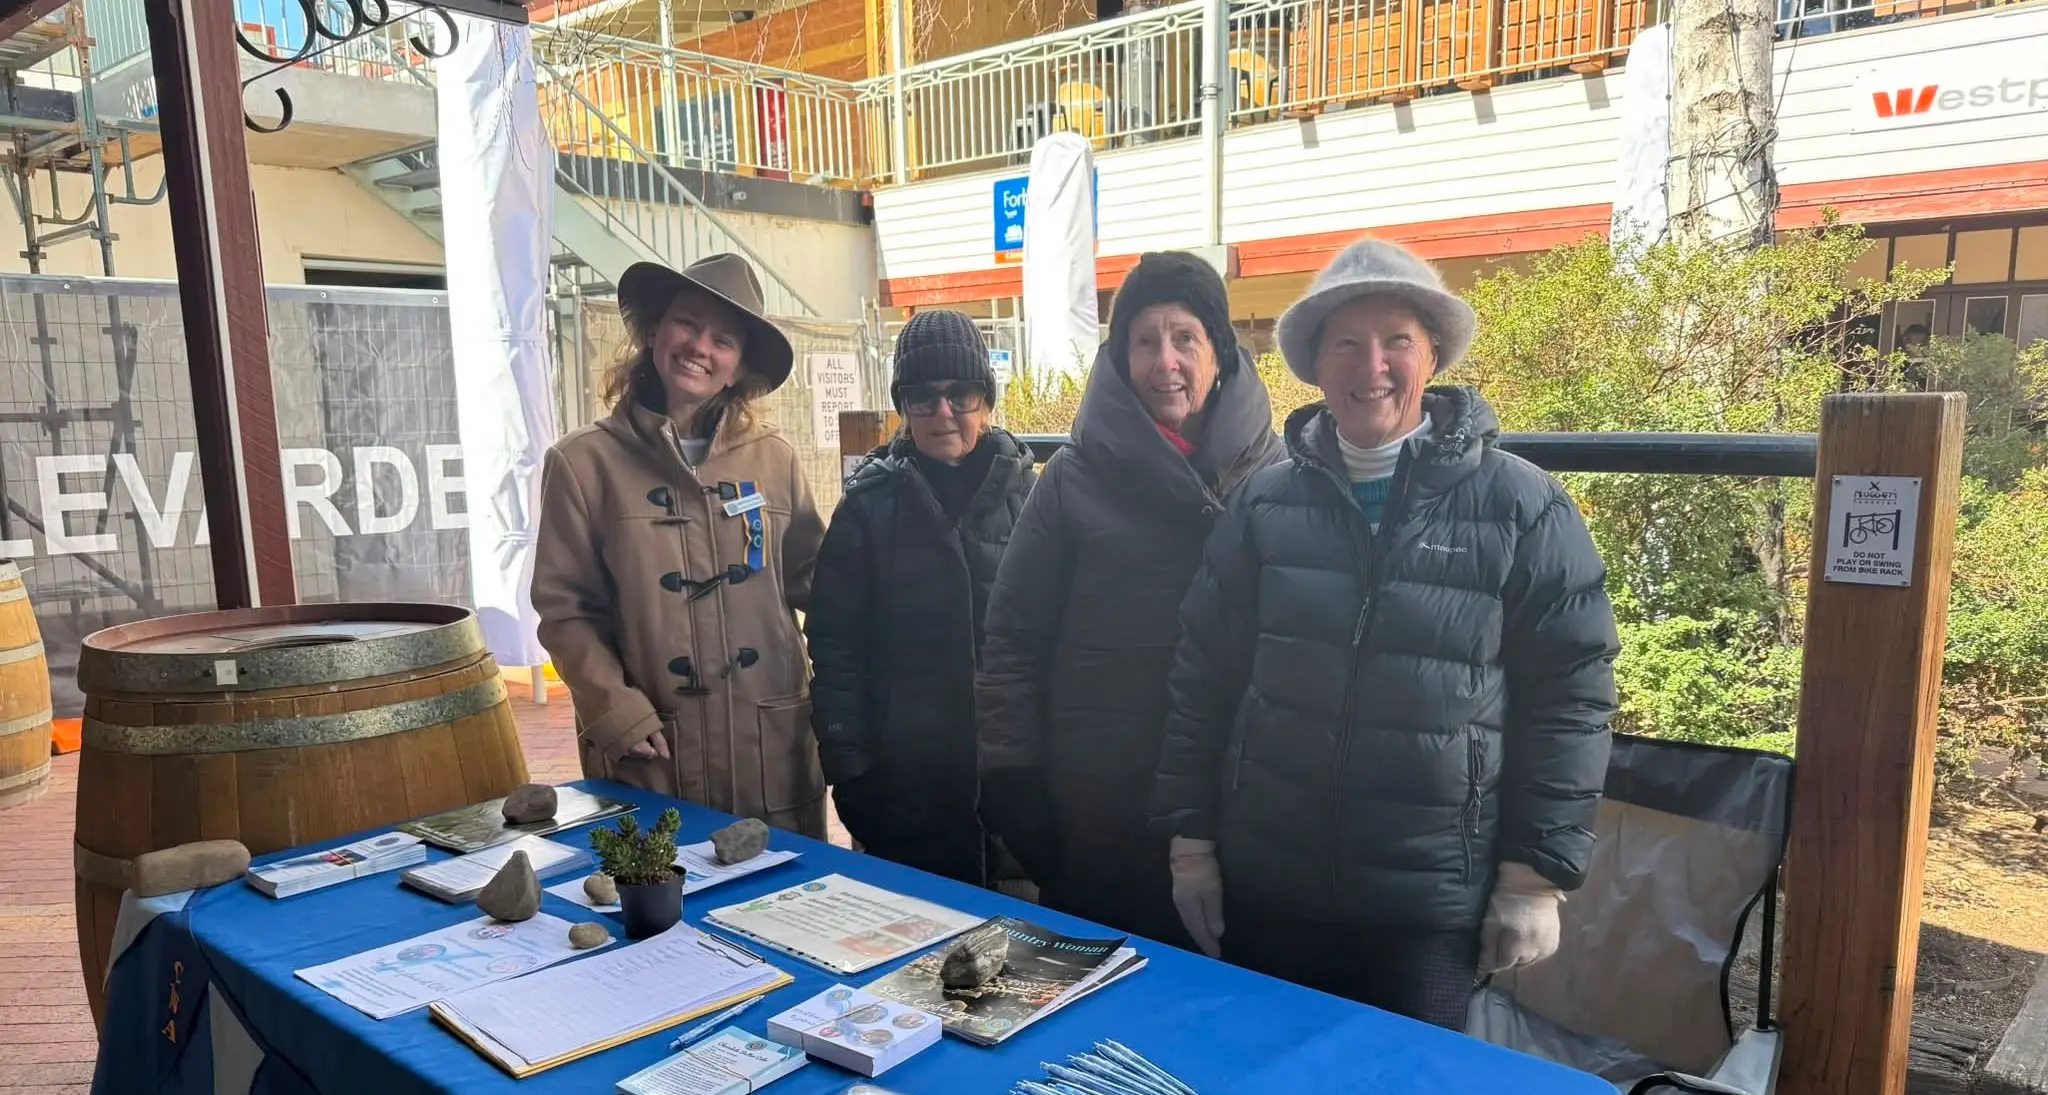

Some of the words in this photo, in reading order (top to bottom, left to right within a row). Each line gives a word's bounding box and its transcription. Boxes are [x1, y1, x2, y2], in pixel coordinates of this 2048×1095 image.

[826, 358, 844, 370] ALL
[817, 373, 855, 385] VISITORS
[825, 387, 848, 399] MUST
[821, 401, 854, 413] REPORT
[824, 416, 834, 427] TO
[0, 443, 472, 558] EVRDE
[1853, 551, 1866, 559] DO
[1867, 552, 1886, 560] NOT
[1836, 557, 1857, 566] PLAY
[1858, 559, 1872, 567] OR
[1873, 560, 1902, 568] SWING
[1832, 565, 1857, 573] FROM
[1858, 566, 1878, 575] BIKE
[1879, 568, 1904, 577] RACK
